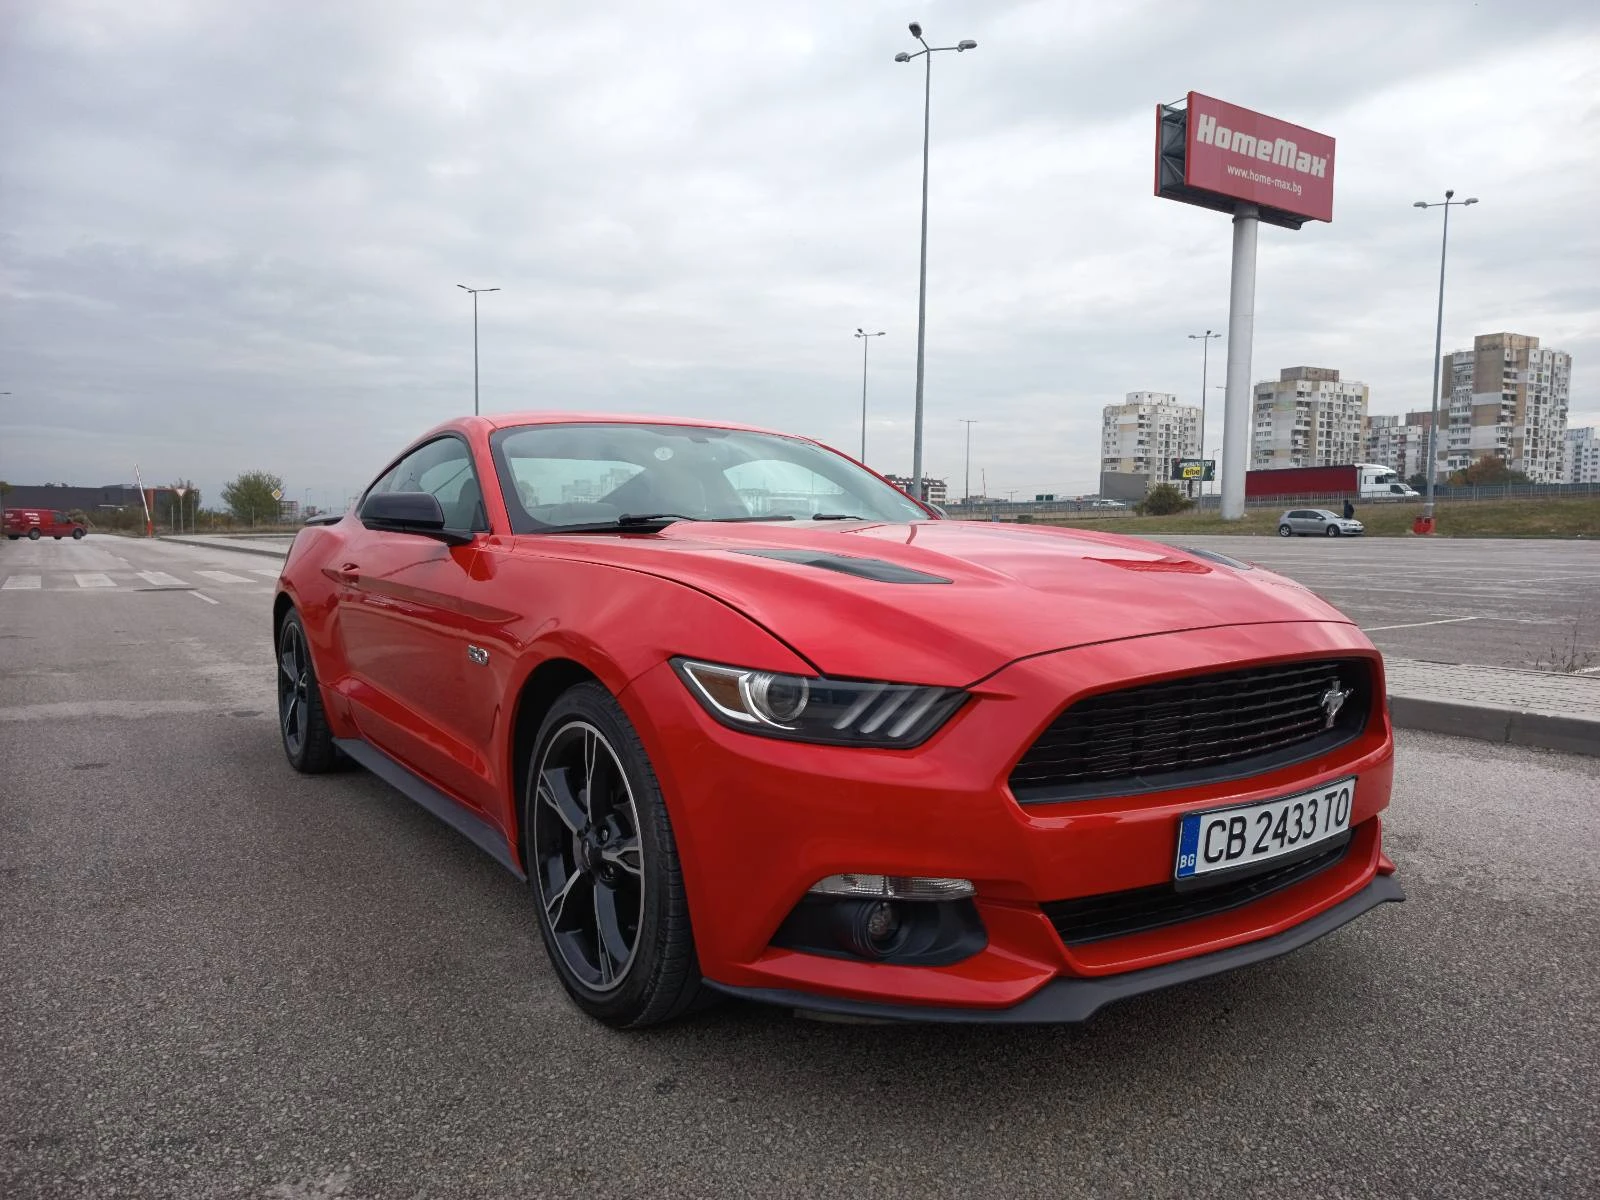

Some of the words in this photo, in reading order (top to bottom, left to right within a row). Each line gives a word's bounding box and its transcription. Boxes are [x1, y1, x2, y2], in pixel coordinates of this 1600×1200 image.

[1197, 114, 1327, 178] HomeMax
[1227, 164, 1302, 195] www.home-max.bg
[1204, 815, 1247, 863] CB
[1252, 799, 1318, 855] 2433
[1324, 788, 1349, 832] TO
[1180, 854, 1196, 869] BG
